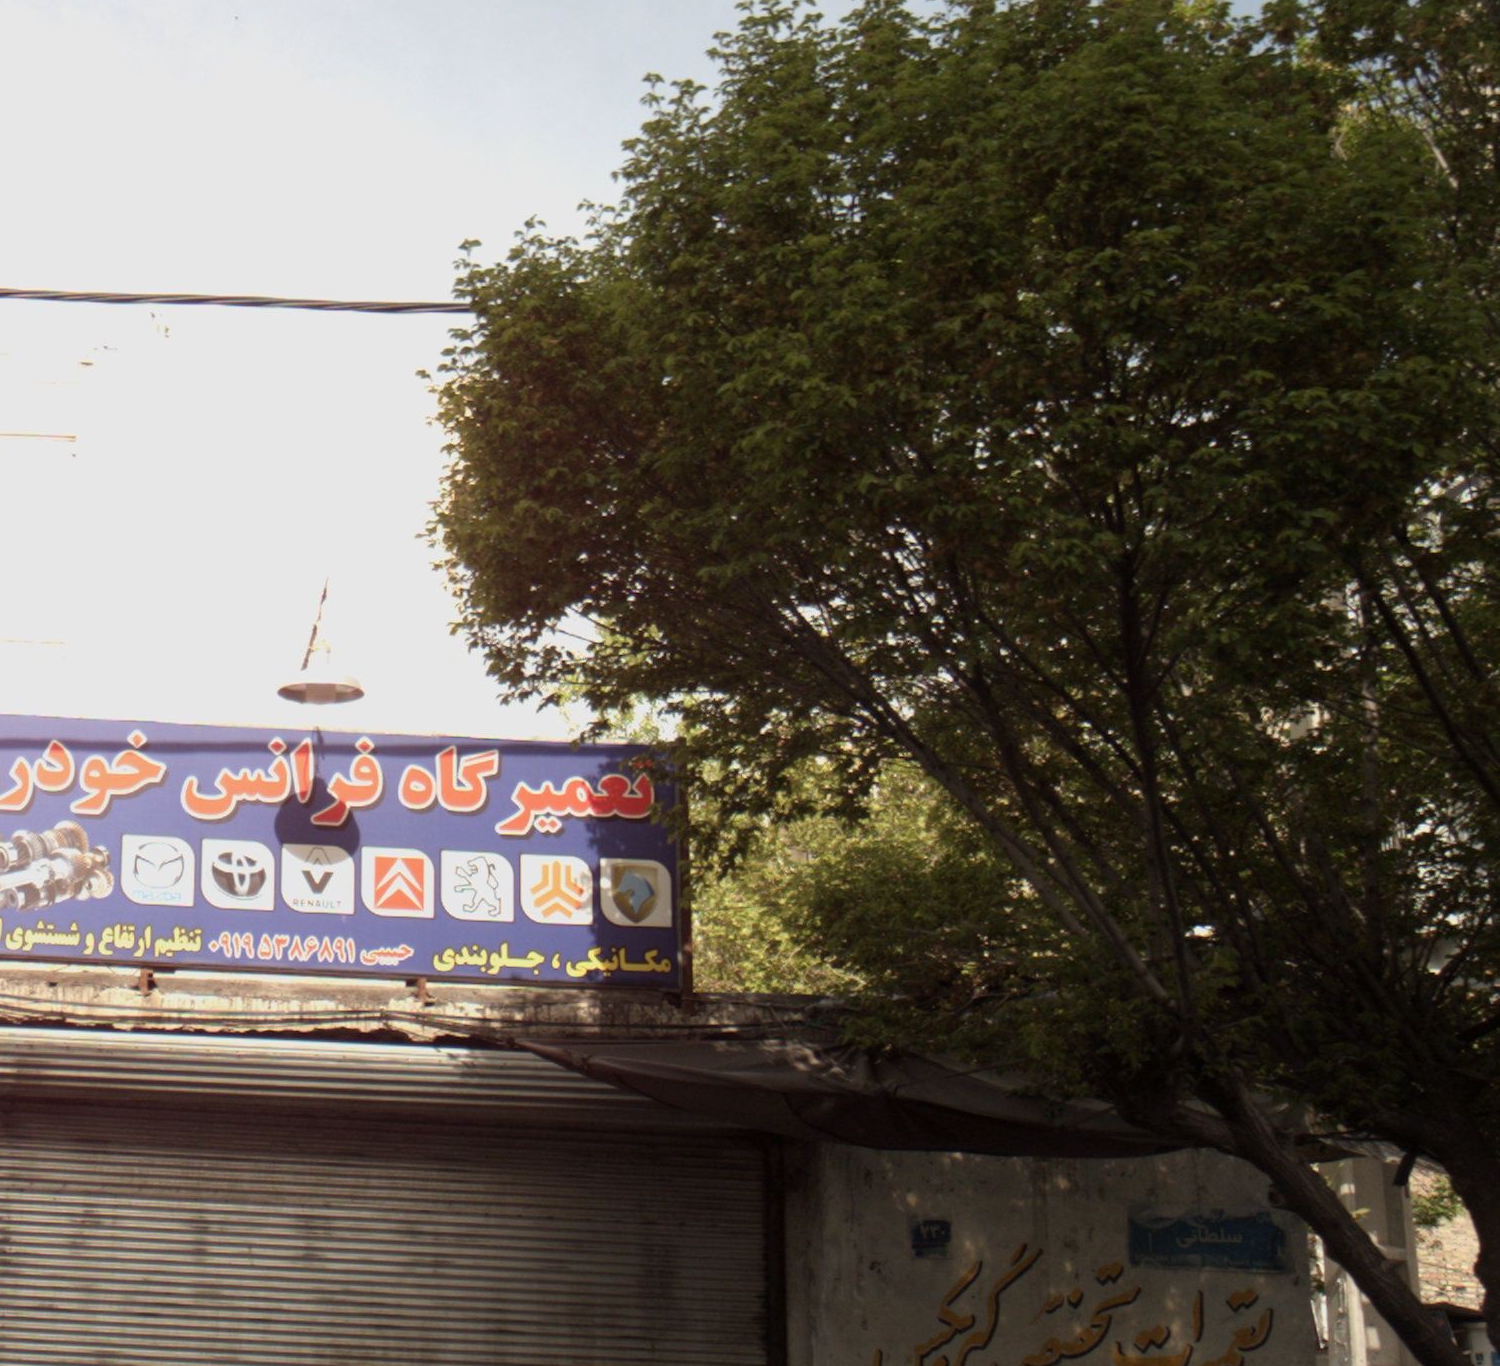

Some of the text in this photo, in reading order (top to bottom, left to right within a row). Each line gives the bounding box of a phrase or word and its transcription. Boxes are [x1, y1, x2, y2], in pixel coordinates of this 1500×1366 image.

[180, 735, 384, 827] فرانس
[292, 898, 342, 910] RENAULT
[5, 919, 81, 952] شستشوی
[82, 930, 96, 955] و
[98, 924, 152, 958] ارتفاع
[155, 925, 203, 959] تنظیم
[432, 942, 545, 975] جلوبندی
